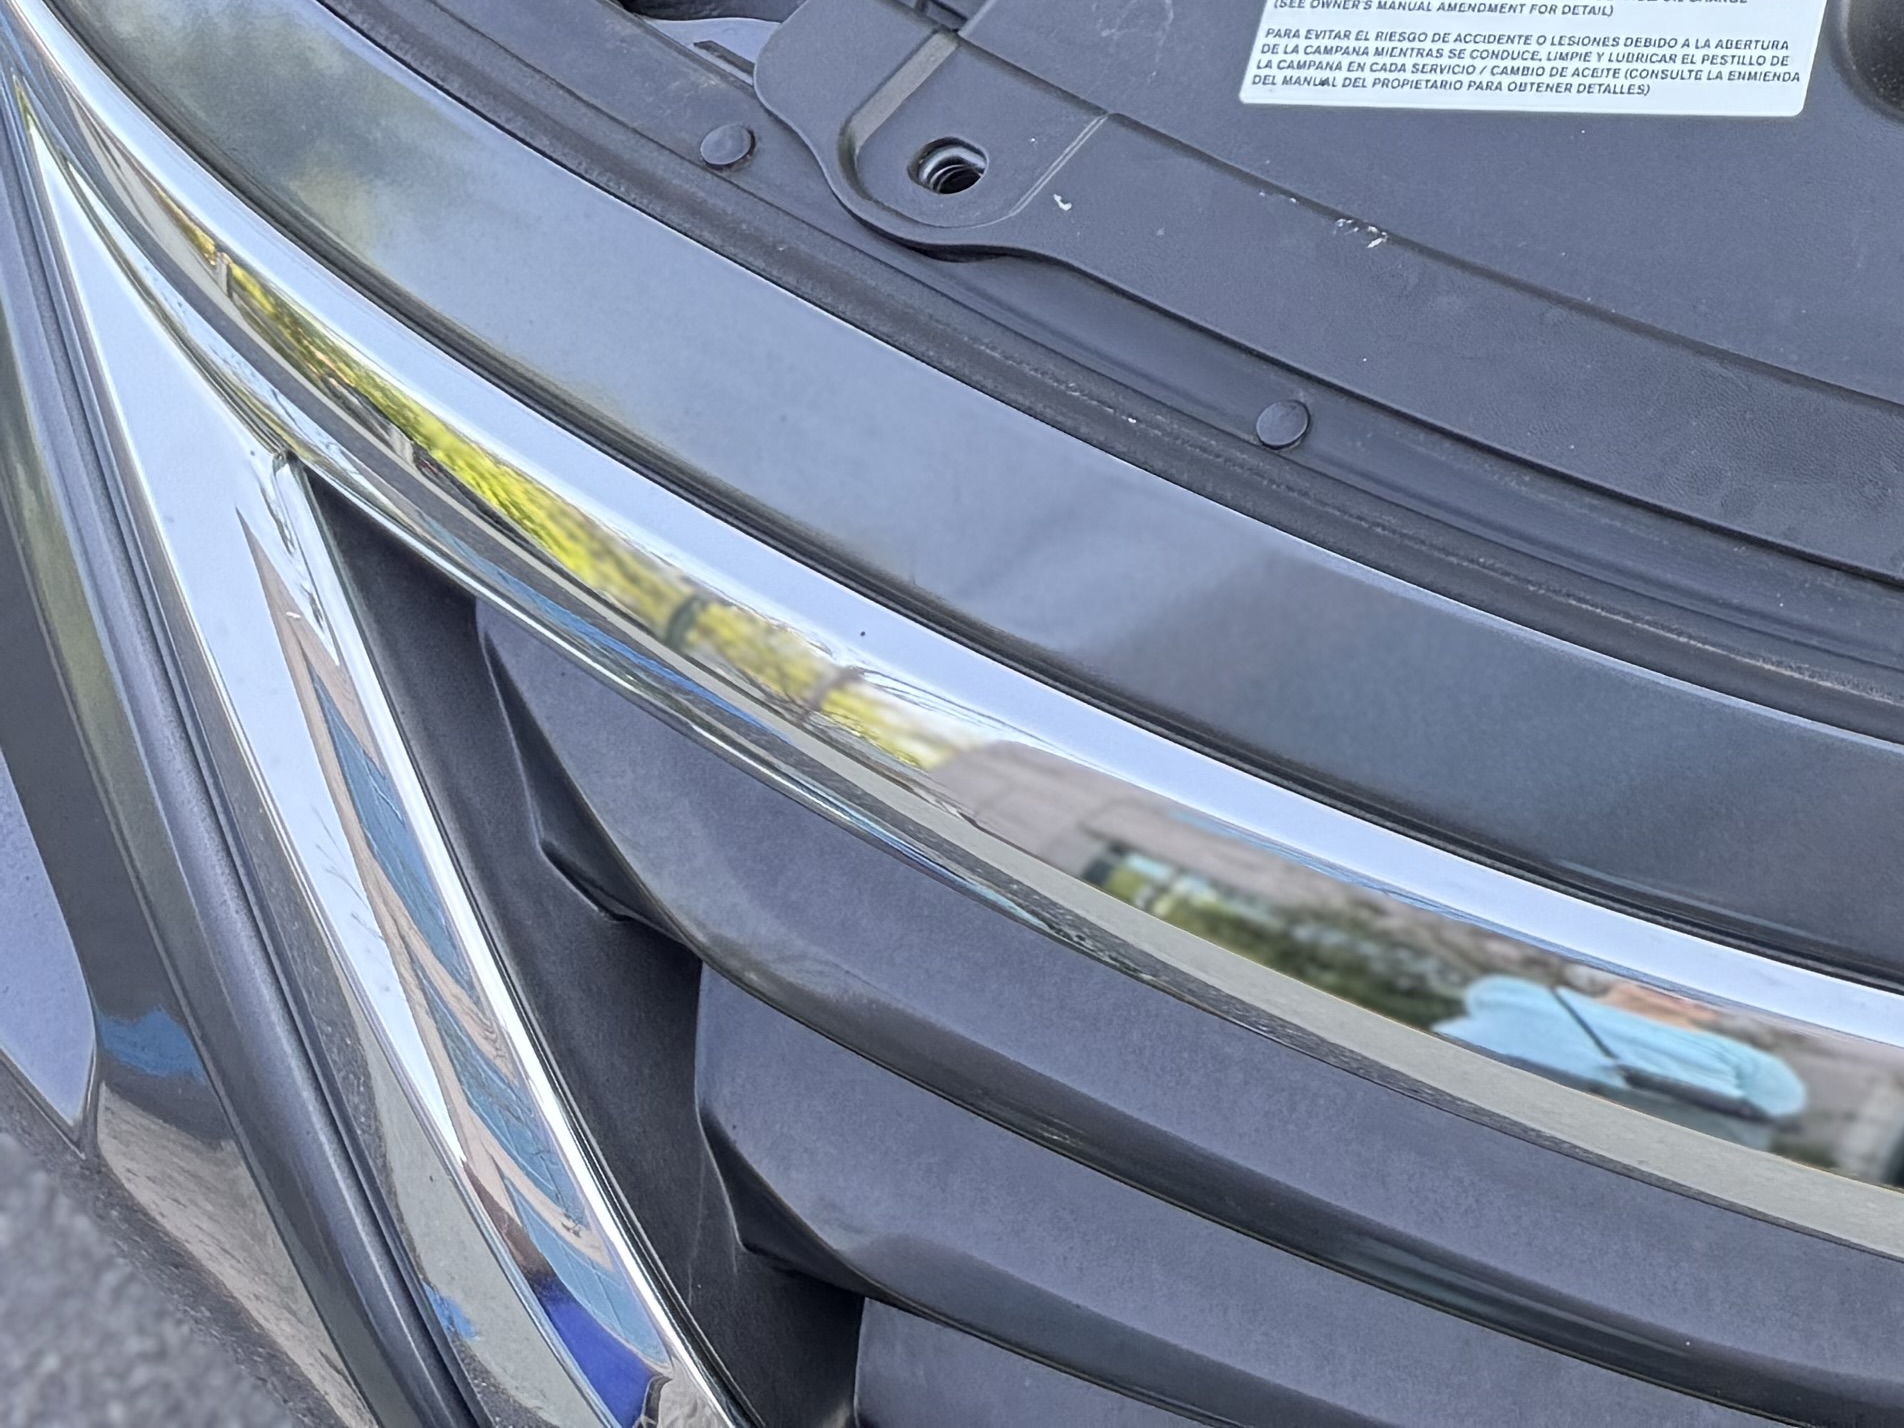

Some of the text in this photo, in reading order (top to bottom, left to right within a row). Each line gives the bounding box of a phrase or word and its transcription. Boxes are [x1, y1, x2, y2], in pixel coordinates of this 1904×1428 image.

[1376, 0, 1432, 11] MANUAL
[1436, 2, 1526, 14] AMENDMENT
[1529, 4, 1558, 14] FOR
[1561, 4, 1613, 16] DETAIL)
[1265, 28, 1788, 50] PARA EVITAR EL RIESGO DE ACCIDENTE O LESIONES DEBIDO A LA ABERTURA
[1260, 44, 1280, 54] DE
[1283, 44, 1299, 54] LA
[1303, 45, 1369, 56] CAMPANA
[1373, 46, 1444, 58] MIENTRAS
[1447, 48, 1466, 59] SE
[1546, 51, 1592, 62] LIMPIE
[1596, 52, 1604, 62] Y
[1607, 52, 1677, 63] LUBRICAR
[1681, 54, 1696, 64] EL
[1701, 54, 1766, 66] PESTILLO
[1769, 55, 1790, 66] DE
[1256, 60, 1272, 69] LA
[1276, 60, 1342, 71] CAMPANA
[1346, 62, 1366, 72] EN
[1369, 62, 1406, 73] CADA
[1410, 63, 1476, 75] SERVICIO
[1490, 65, 1545, 76] CAMBIO
[1548, 66, 1568, 77] DE
[1571, 67, 1621, 78] ACEITE
[1624, 68, 1703, 80] (CONSULTE
[1706, 70, 1723, 80] LA
[1727, 70, 1800, 82] ENMIENDA
[1251, 75, 1650, 94] DEL MANUAL DEL PROPIETARIO PARA OBTENER DETALLES)
